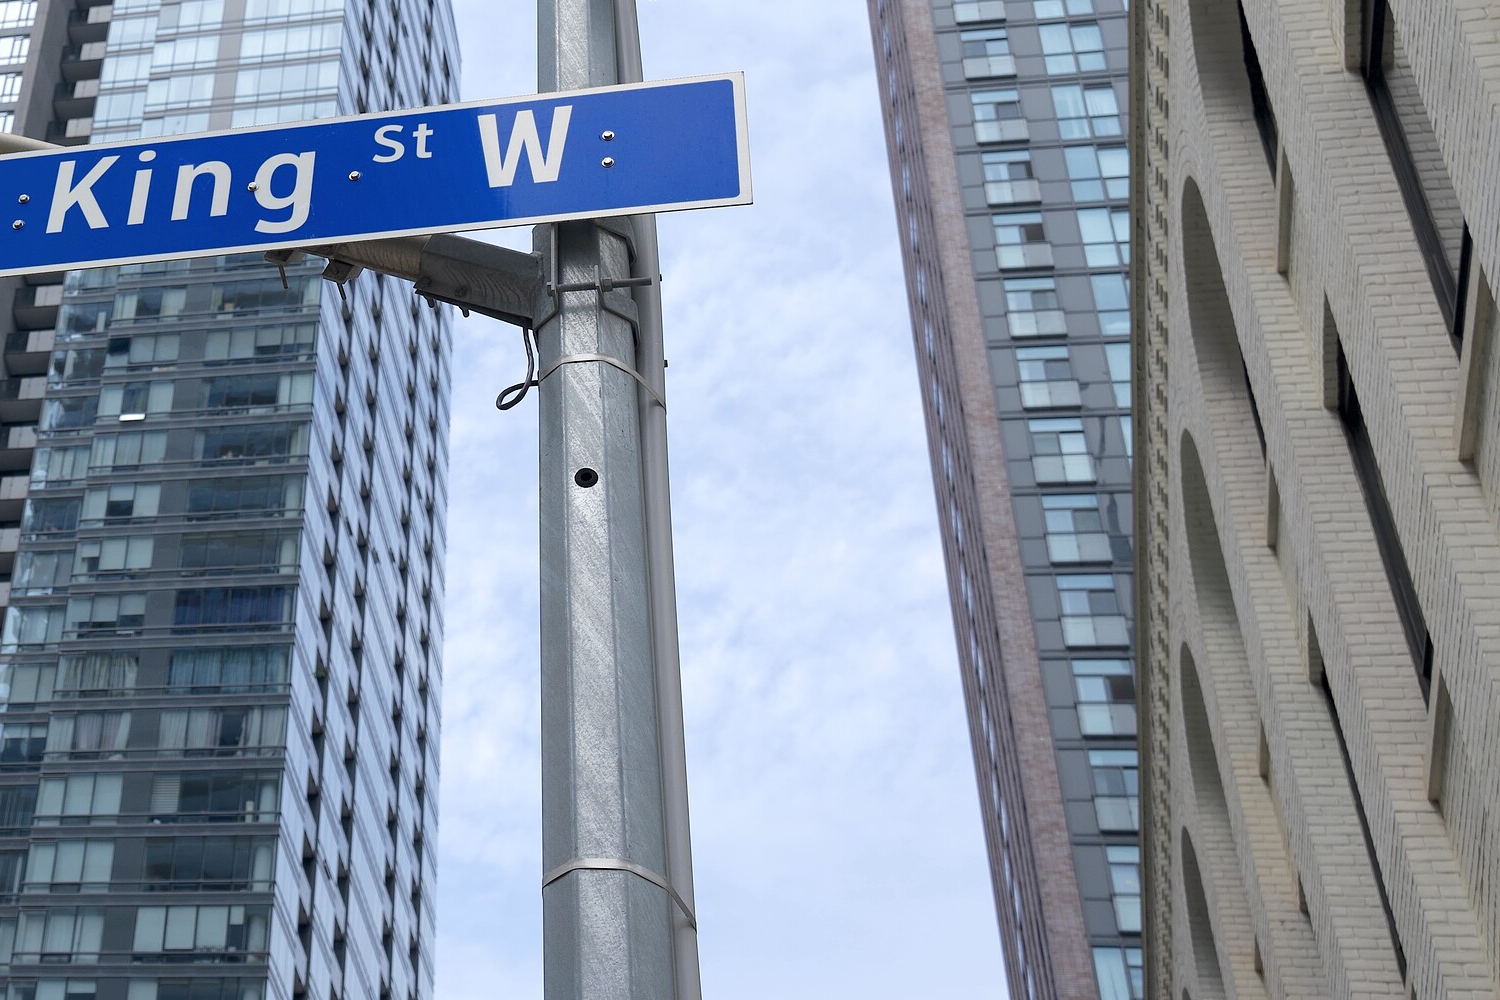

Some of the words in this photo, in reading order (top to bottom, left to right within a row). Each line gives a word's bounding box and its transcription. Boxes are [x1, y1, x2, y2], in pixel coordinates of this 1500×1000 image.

[45, 150, 317, 234] King
[372, 123, 433, 163] St
[477, 105, 573, 188] W
